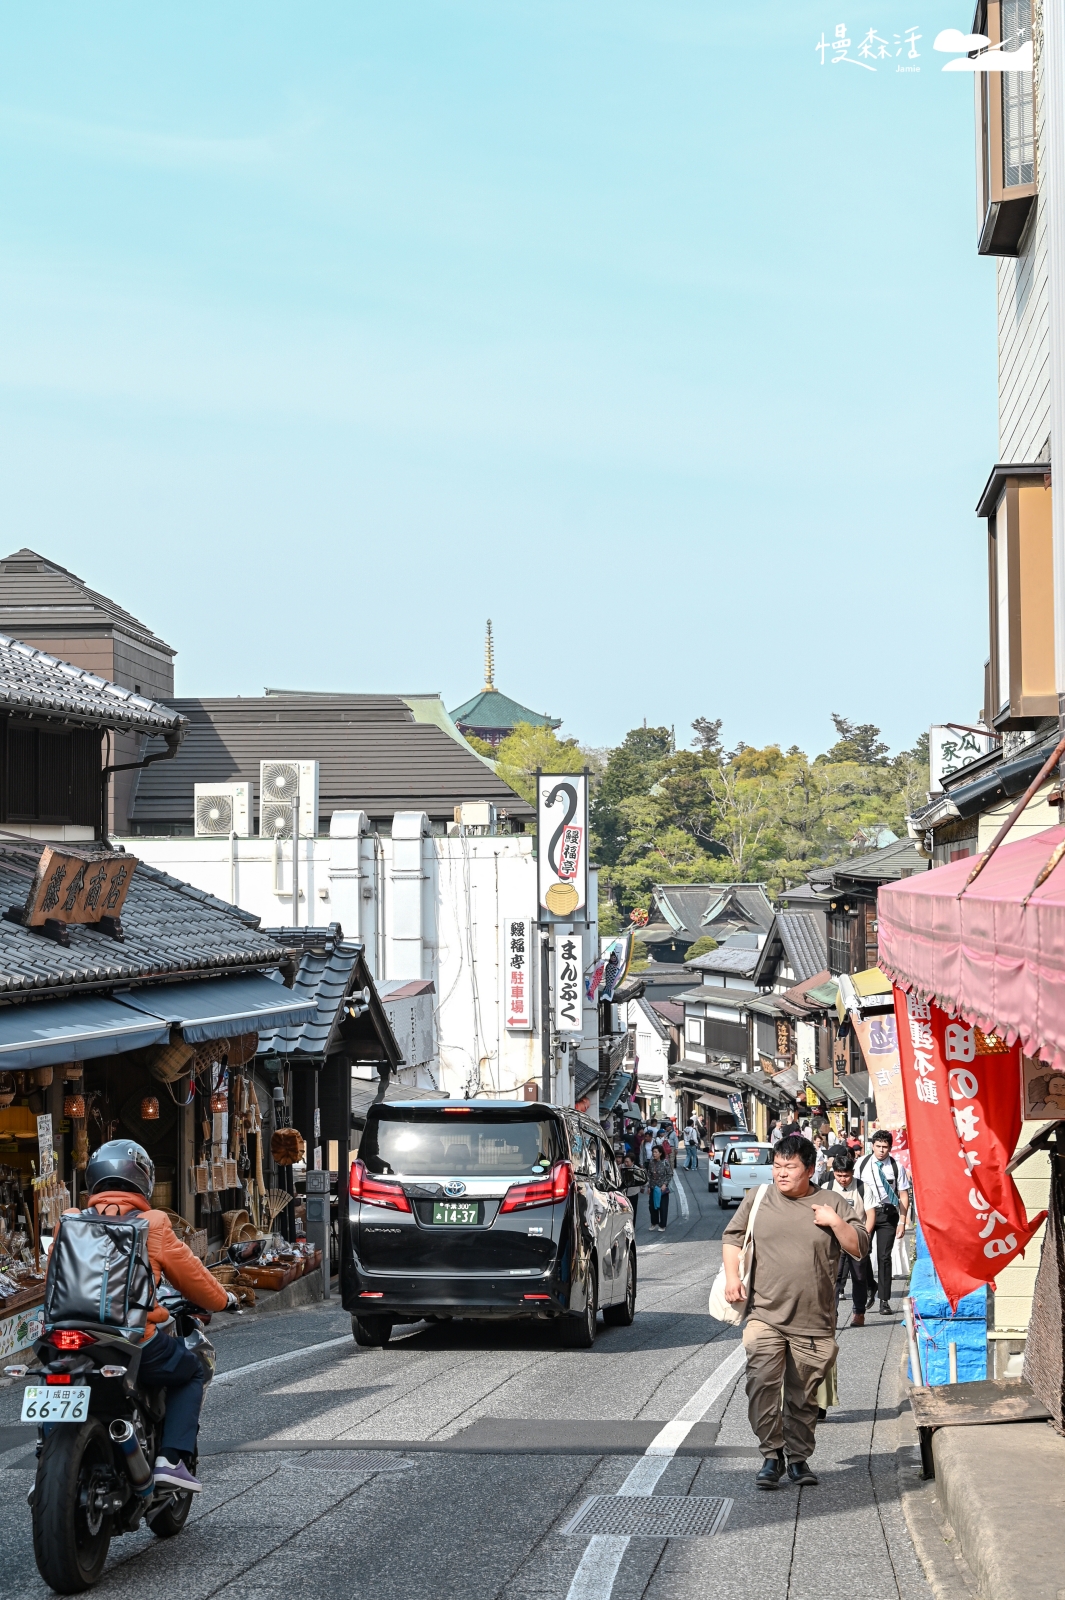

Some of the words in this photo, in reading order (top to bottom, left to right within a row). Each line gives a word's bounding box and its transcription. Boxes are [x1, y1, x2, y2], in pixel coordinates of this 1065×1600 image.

[559, 939, 577, 1023] まんぷく
[444, 1210, 476, 1223] 14-37
[26, 1401, 84, 1419] 66-76
